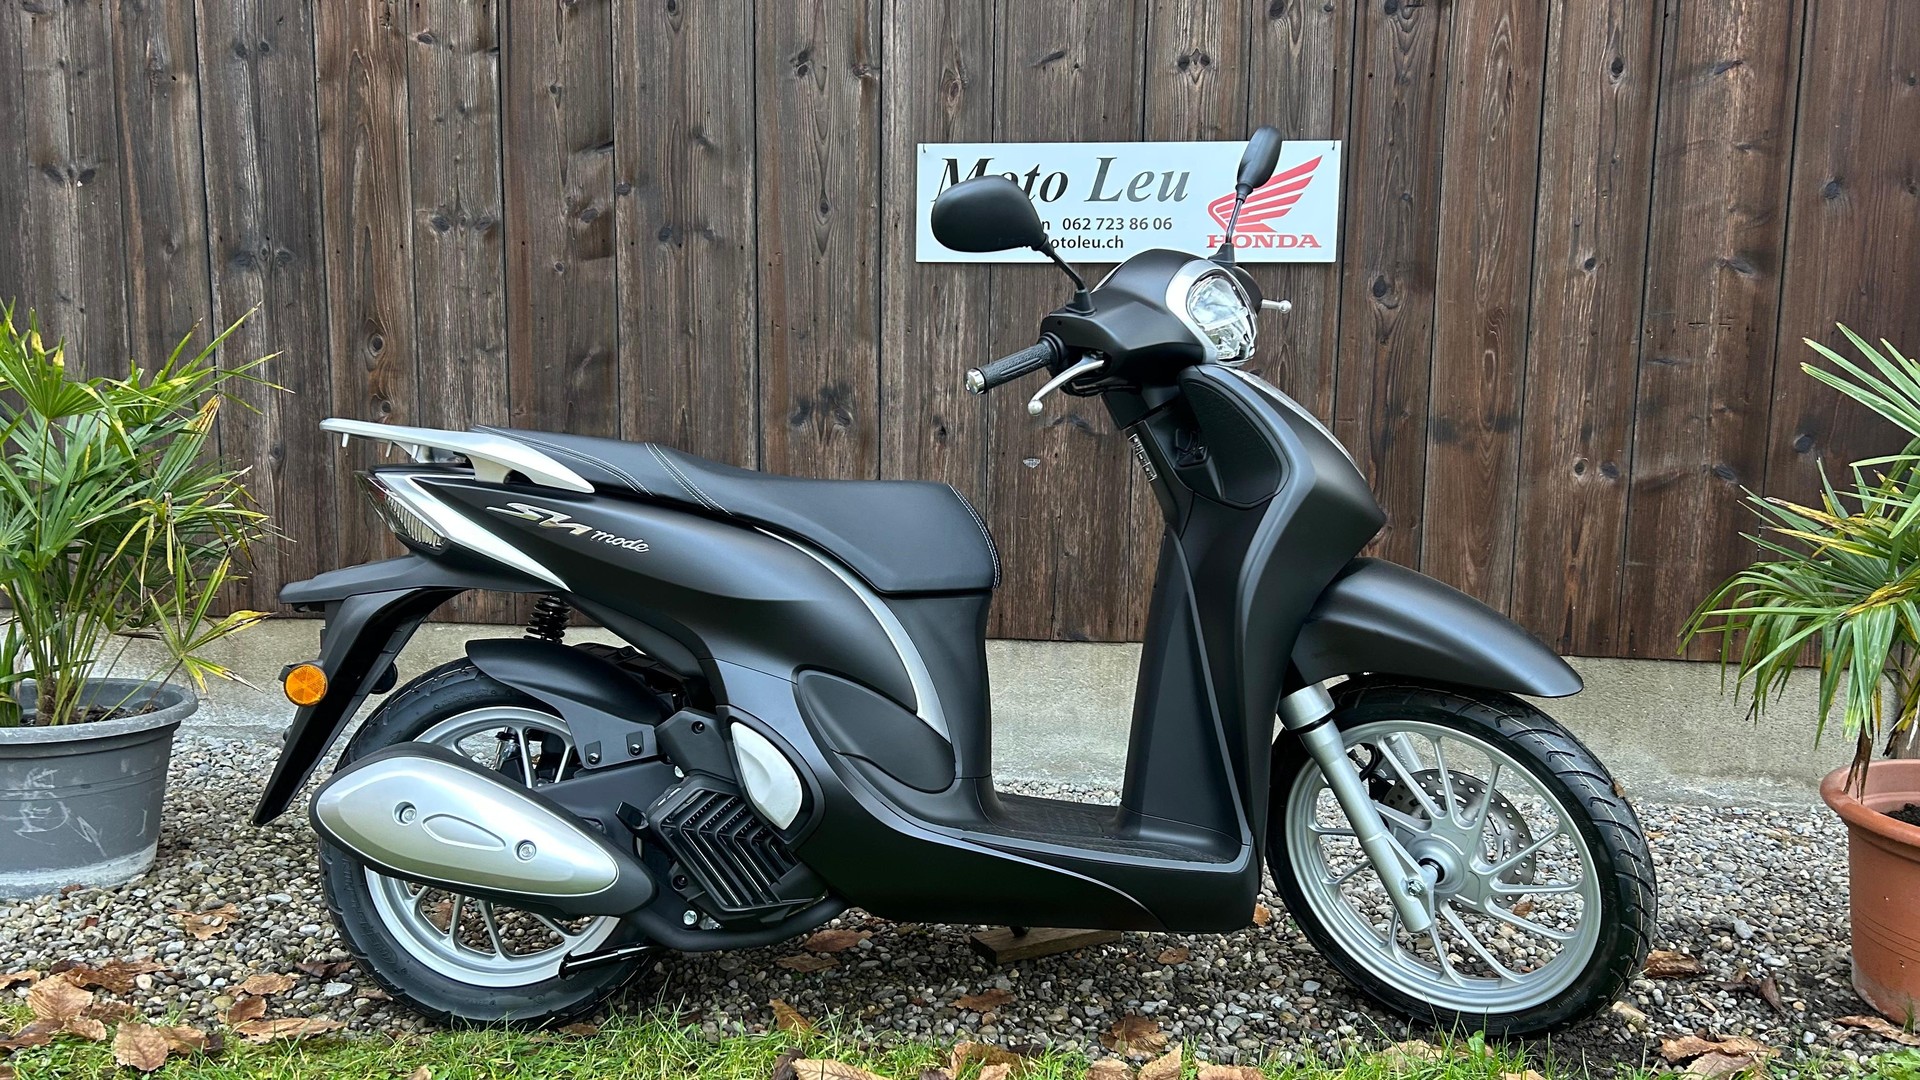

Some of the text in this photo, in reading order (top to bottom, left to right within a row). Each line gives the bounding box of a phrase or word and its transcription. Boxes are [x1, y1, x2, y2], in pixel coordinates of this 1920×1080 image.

[1083, 156, 1190, 203] Leu
[1062, 217, 1091, 231] 062
[1096, 217, 1125, 231] 723
[1129, 217, 1149, 231] 86
[1153, 217, 1173, 231] 06
[1051, 235, 1124, 249] otoleu.ch
[1206, 234, 1322, 249] HONDA
[591, 529, 650, 553] mode
